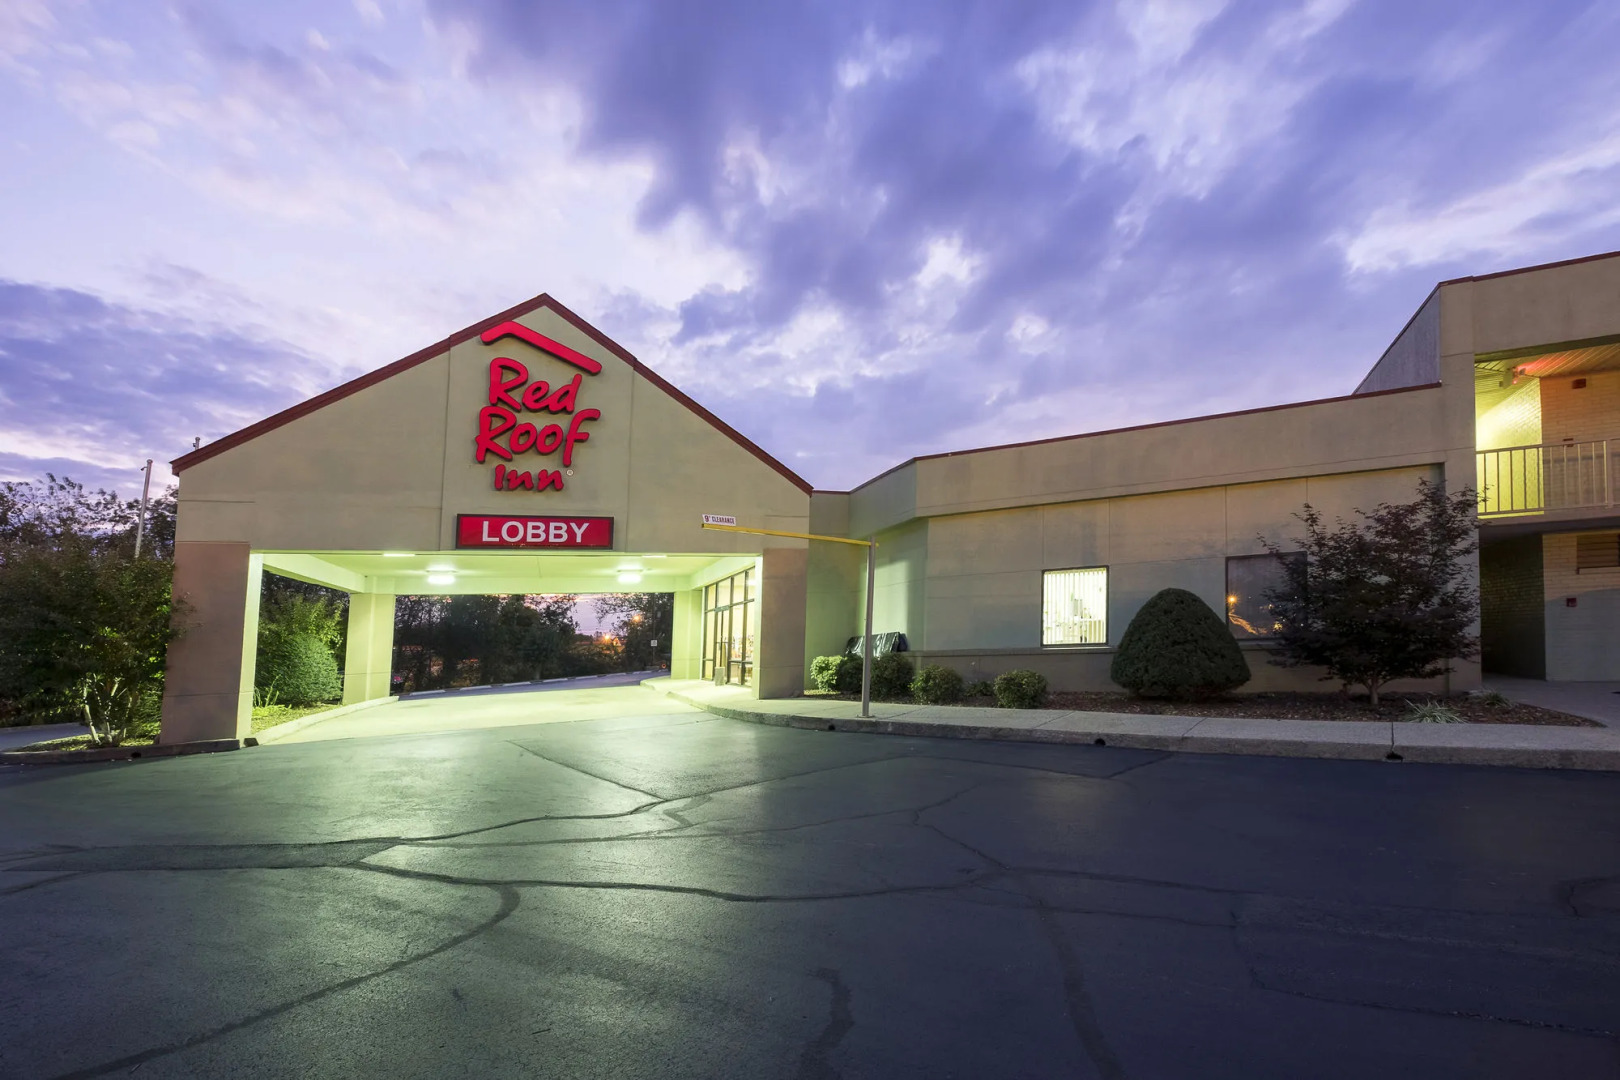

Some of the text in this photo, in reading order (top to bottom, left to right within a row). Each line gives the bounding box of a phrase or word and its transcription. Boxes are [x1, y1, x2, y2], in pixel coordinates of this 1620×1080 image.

[489, 357, 582, 413] Red
[475, 405, 601, 466] Roof
[494, 463, 564, 491] Inn
[482, 520, 590, 543] LOBBY
